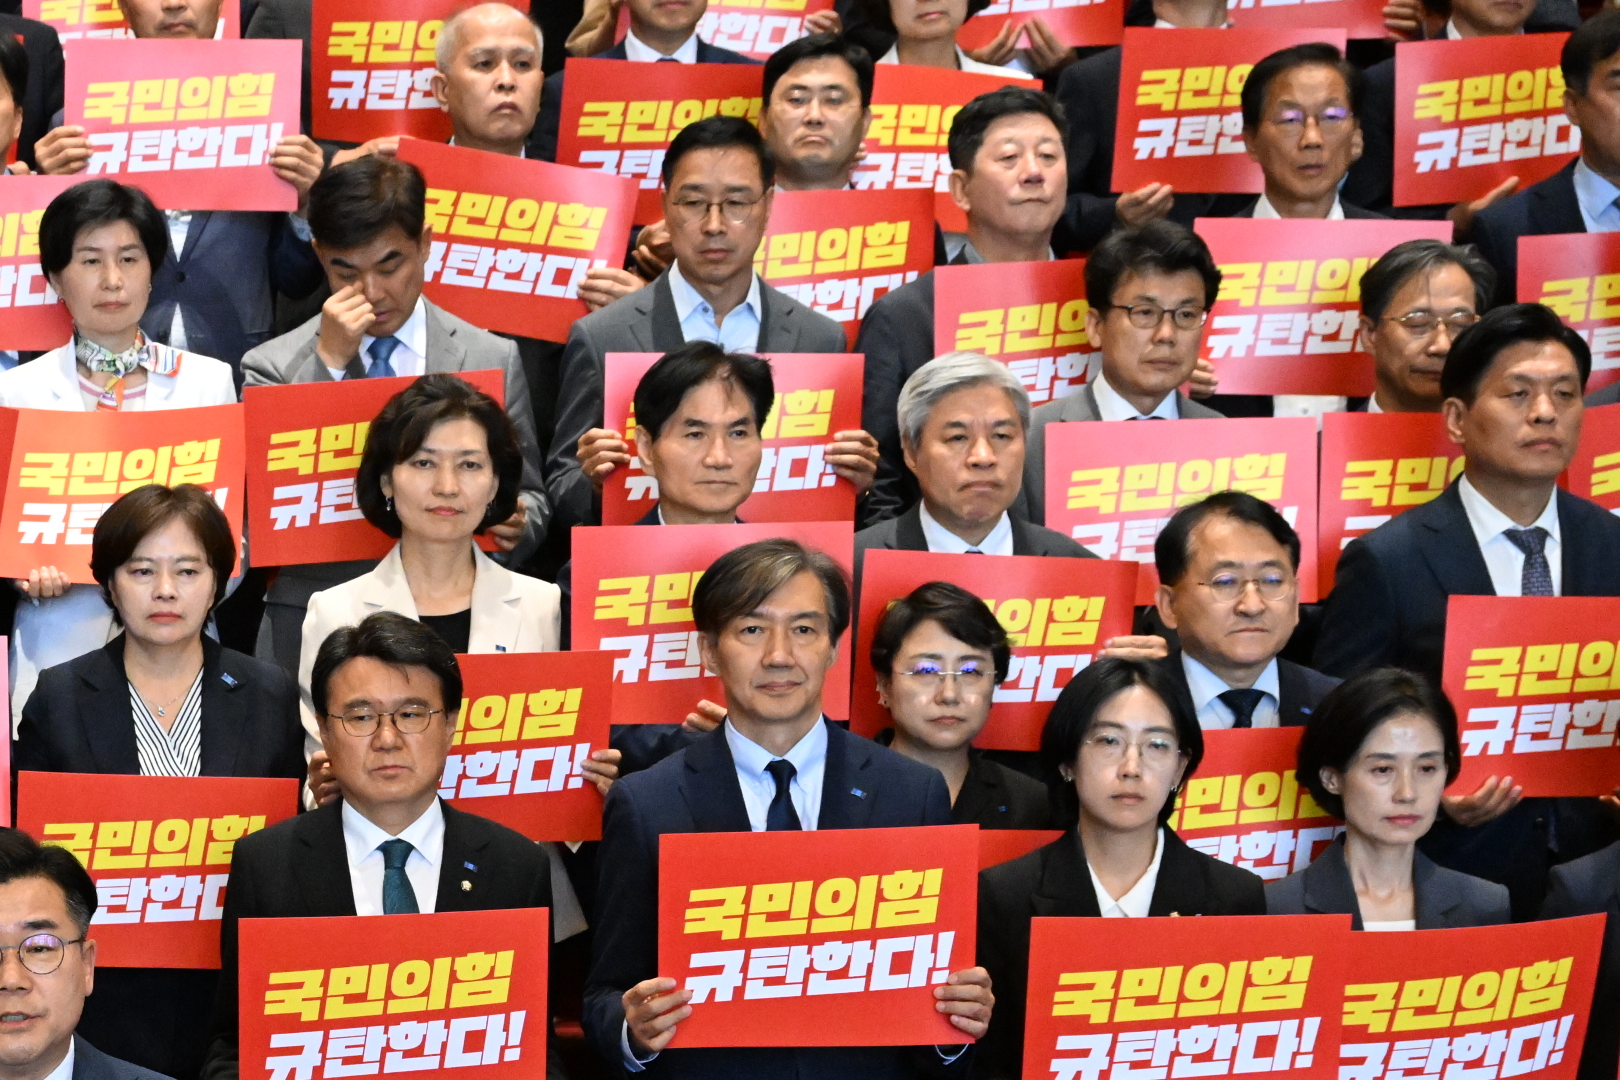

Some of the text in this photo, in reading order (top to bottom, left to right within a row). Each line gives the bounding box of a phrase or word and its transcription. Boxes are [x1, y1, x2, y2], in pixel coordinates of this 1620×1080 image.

[84, 73, 276, 125] 국민의힘
[89, 122, 284, 176] 규탄한다!
[1414, 114, 1582, 173] 규탄한다
[18, 438, 221, 497] 국민의힘
[267, 422, 370, 475] 국민
[987, 596, 1106, 647] 의힘
[452, 688, 583, 747] 의힘
[1463, 698, 1620, 757] 규탄한
[437, 743, 591, 800] 한다!
[683, 868, 944, 941] 국민의힘
[265, 950, 515, 1022] 국민의힘
[682, 931, 956, 1005] 규탄한다!
[1052, 956, 1314, 1023] 국민의힘
[1342, 957, 1574, 1033] 국민의힘
